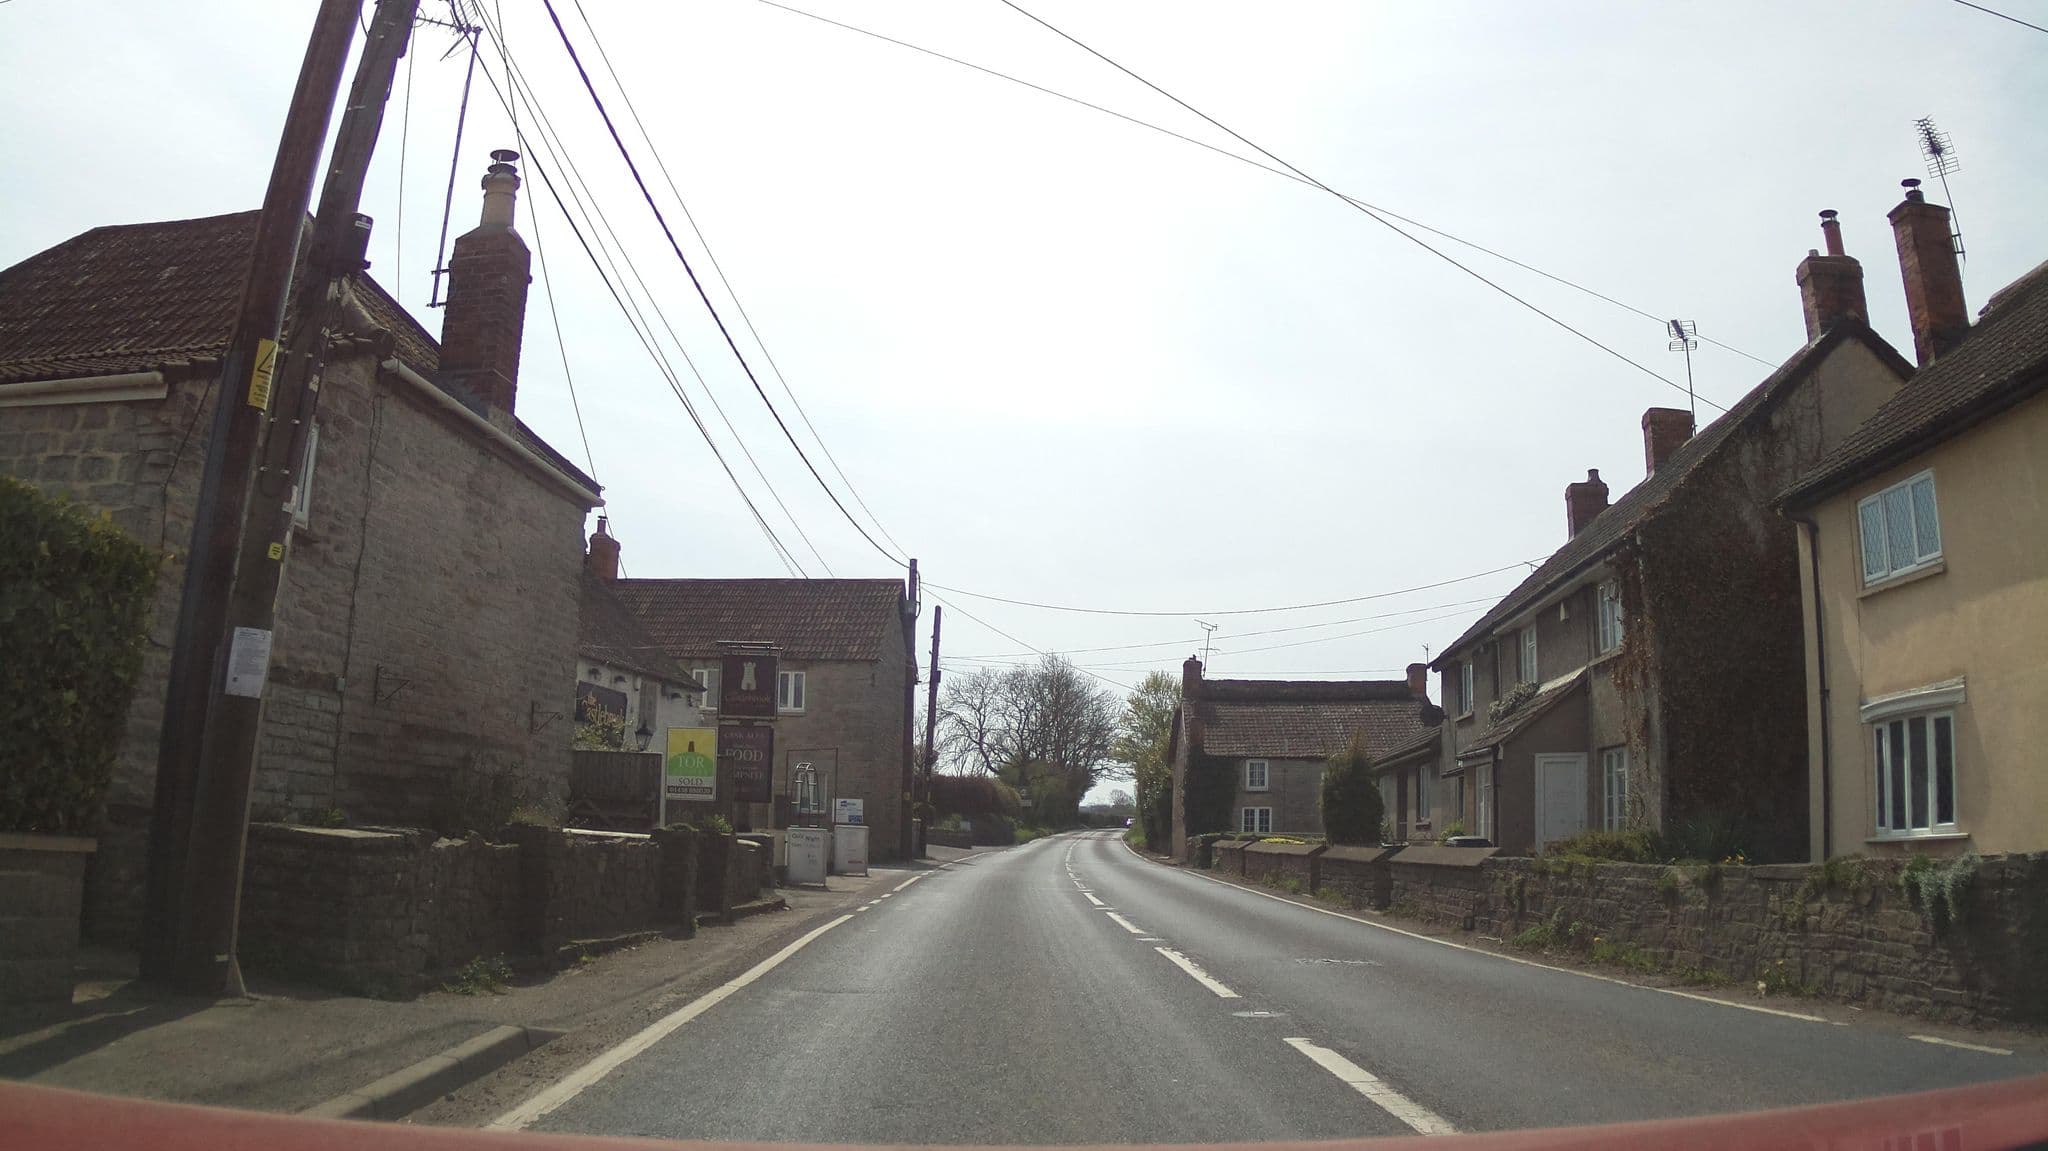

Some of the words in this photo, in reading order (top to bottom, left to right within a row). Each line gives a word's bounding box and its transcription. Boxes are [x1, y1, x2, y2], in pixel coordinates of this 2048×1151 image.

[725, 748, 764, 761] FOOD
[679, 755, 704, 769] TOR
[678, 777, 704, 786] SOLD
